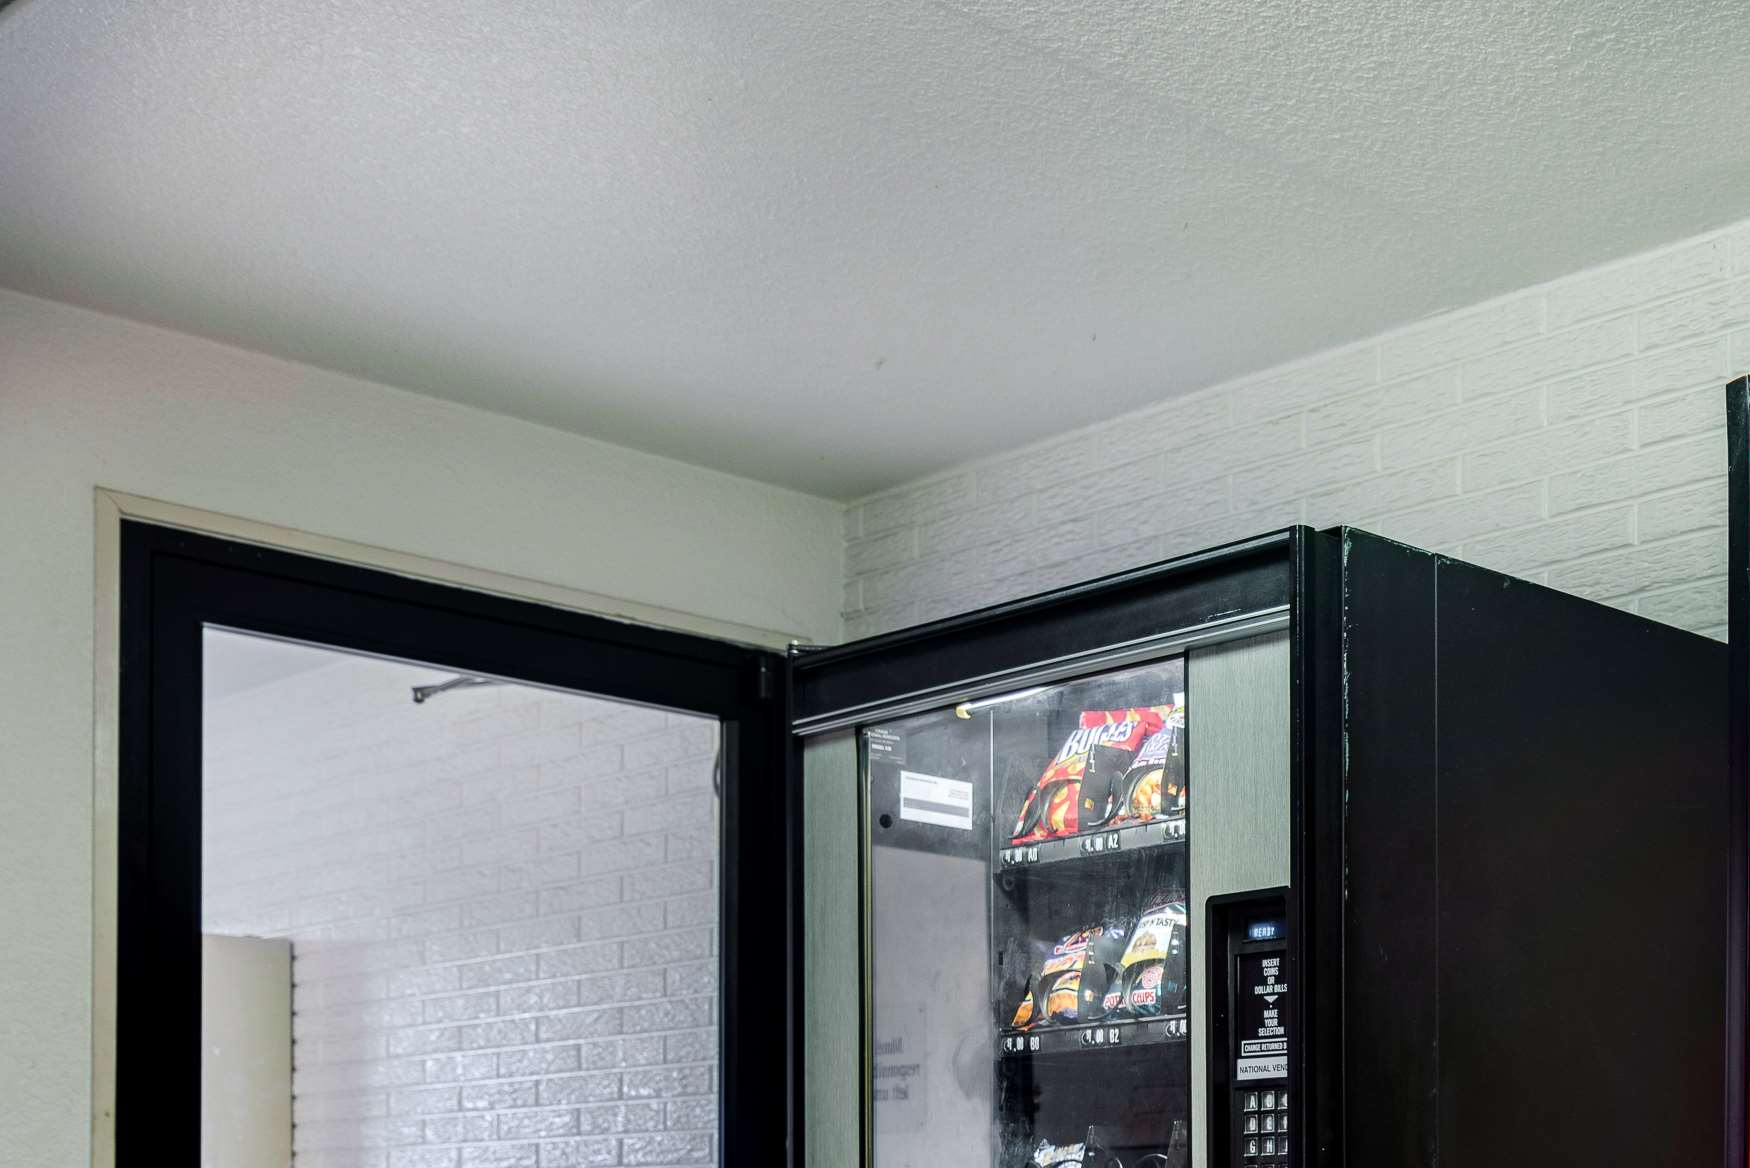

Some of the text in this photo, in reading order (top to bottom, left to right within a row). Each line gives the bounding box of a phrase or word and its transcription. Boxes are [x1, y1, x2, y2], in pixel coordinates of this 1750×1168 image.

[1107, 834, 1119, 849] A2
[1261, 958, 1280, 968] INSERT
[1263, 967, 1279, 976] COINS
[1267, 976, 1275, 985] OR
[1254, 984, 1288, 995] DOLLAR BILLS
[1263, 1009, 1279, 1019] MAKE
[1264, 1018, 1279, 1028] YOUR
[1258, 1026, 1285, 1037] SELECTION
[1240, 1064, 1272, 1074] NATIONAL
[1249, 1139, 1273, 1153] G H
